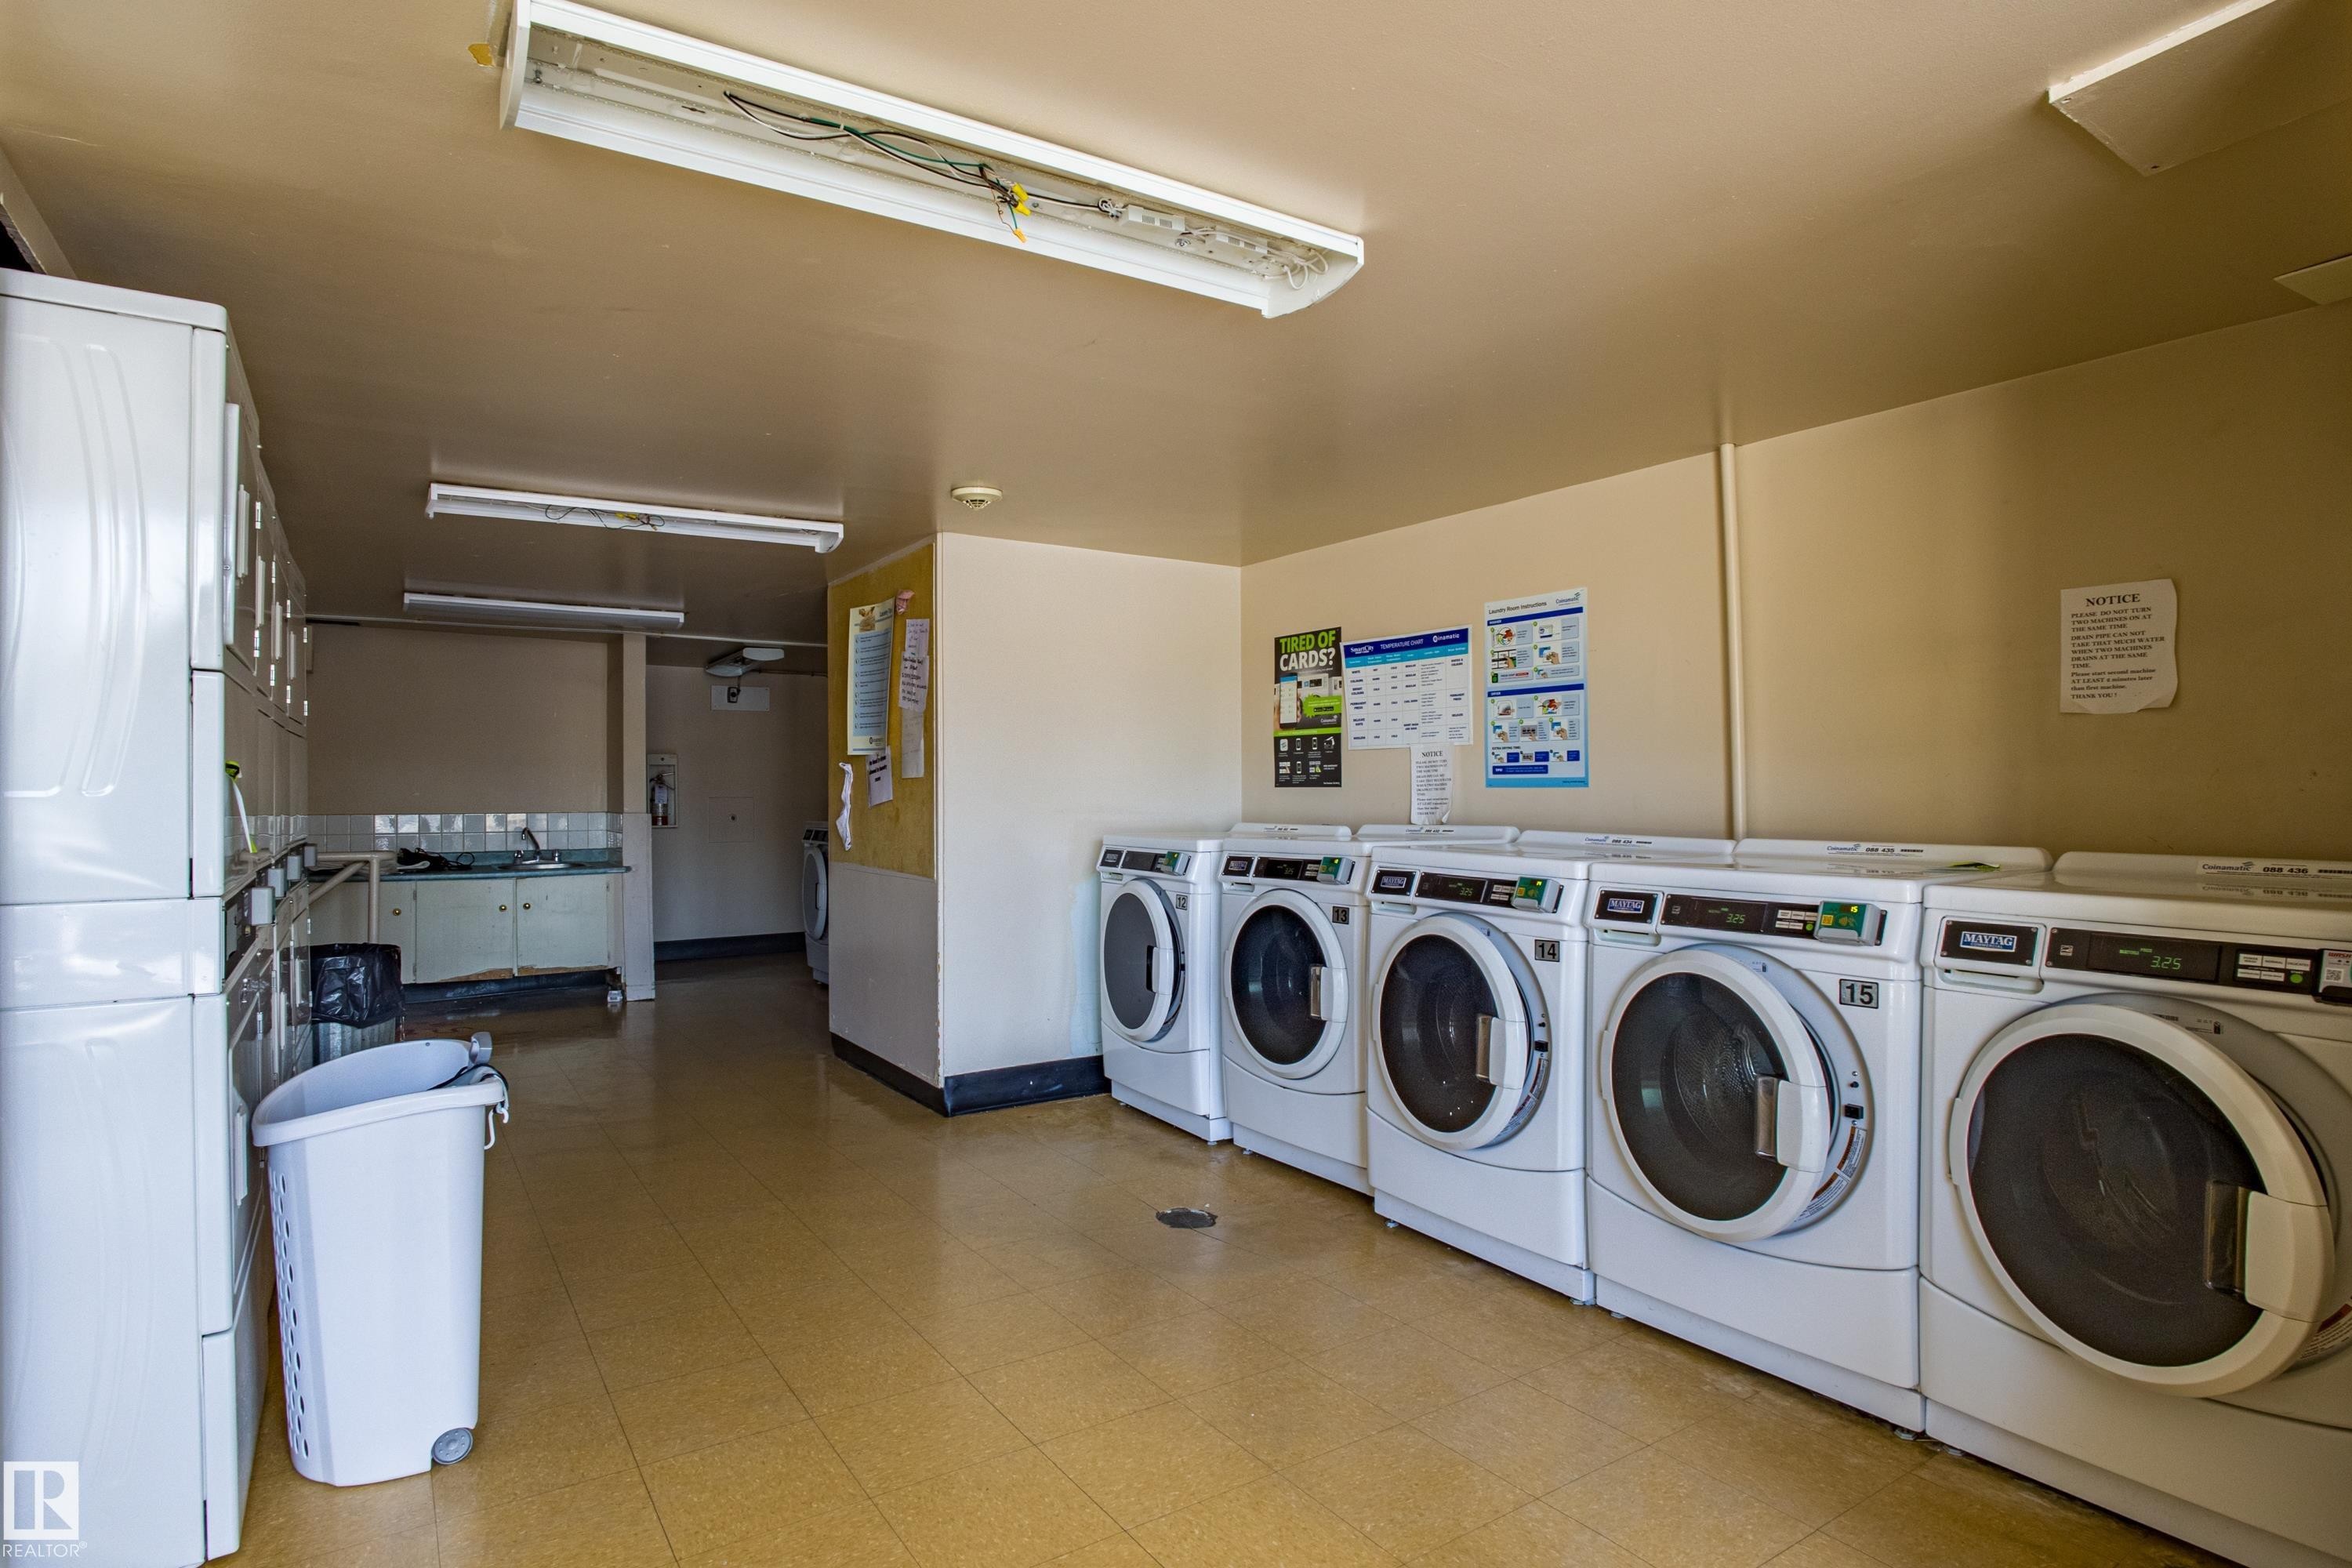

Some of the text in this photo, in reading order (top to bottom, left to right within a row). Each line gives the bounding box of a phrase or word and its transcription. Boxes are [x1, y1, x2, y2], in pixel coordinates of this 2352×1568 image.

[2085, 593, 2140, 607] NOTICE
[1279, 630, 1336, 653] TIRED OF
[1381, 641, 1410, 649] TEMPERATURE
[1279, 648, 1335, 671] CARDS?
[1178, 897, 1186, 908] 12
[1334, 909, 1347, 922] 13
[1964, 934, 2013, 946] MAYTAG
[1537, 943, 1557, 959] 14
[2151, 956, 2182, 970] 3.25
[1846, 983, 1873, 1004] 15
